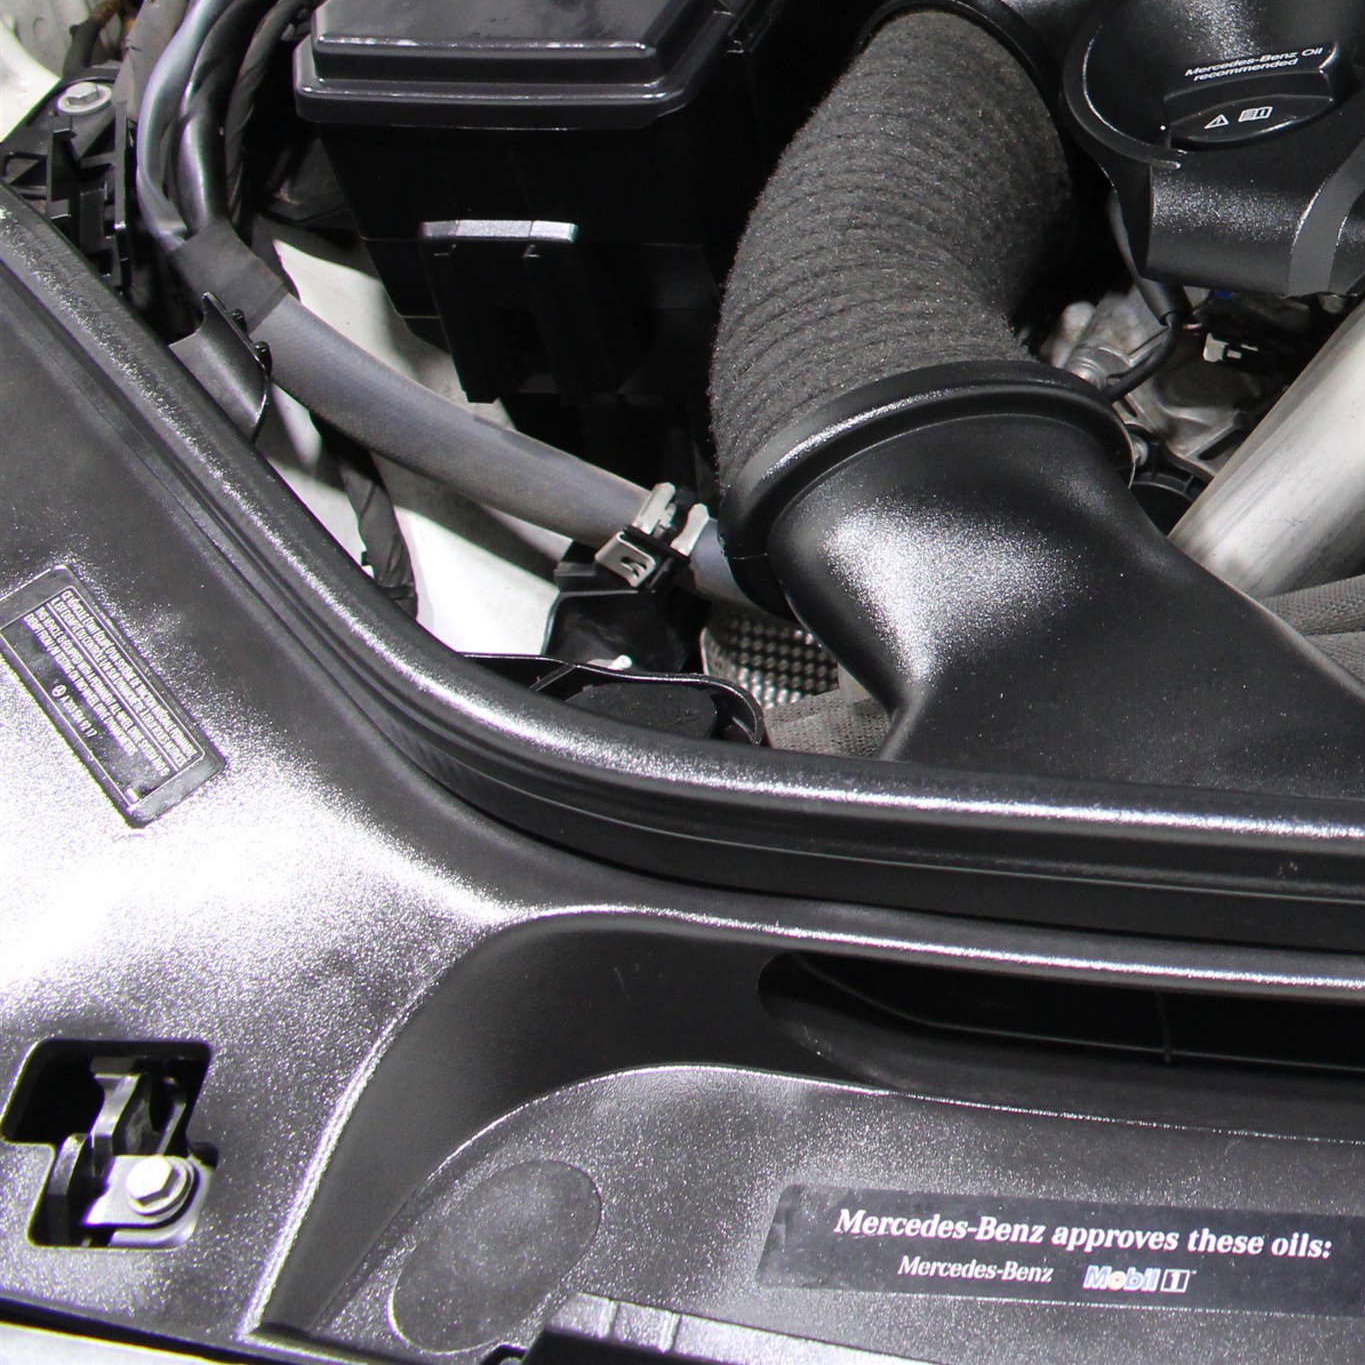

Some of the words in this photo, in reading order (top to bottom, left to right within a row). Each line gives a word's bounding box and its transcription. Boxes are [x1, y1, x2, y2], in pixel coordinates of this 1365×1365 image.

[1184, 51, 1299, 77] Mercedes-Benz
[1301, 47, 1324, 57] Oil
[1193, 58, 1299, 82] recommended
[23, 612, 45, 634] EXEMPT
[34, 605, 50, 621] THIS
[36, 629, 55, 648] FROM
[41, 616, 64, 639] VEHICLE
[53, 651, 75, 674] TESTING
[59, 638, 84, 665] EQUIPPED
[66, 669, 81, 683] ON
[75, 660, 93, 677] WITH
[72, 677, 89, 693] TWO
[87, 675, 116, 707] PERMANENT
[80, 687, 100, 707] WHEEL
[91, 702, 110, 721] DRIVE
[101, 715, 138, 758] DYNAMOMETERS
[125, 725, 145, 745] DRIVE
[136, 738, 158, 763] SYSTEM
[149, 756, 166, 773] AND
[834, 1208, 1044, 1244] Mercedes-Benz
[1051, 1222, 1179, 1254] approves
[1187, 1227, 1264, 1255] these
[1271, 1235, 1333, 1259] oils:
[898, 1254, 1053, 1284] Mercedes-Benz
[1083, 1265, 1160, 1292] Mobil
